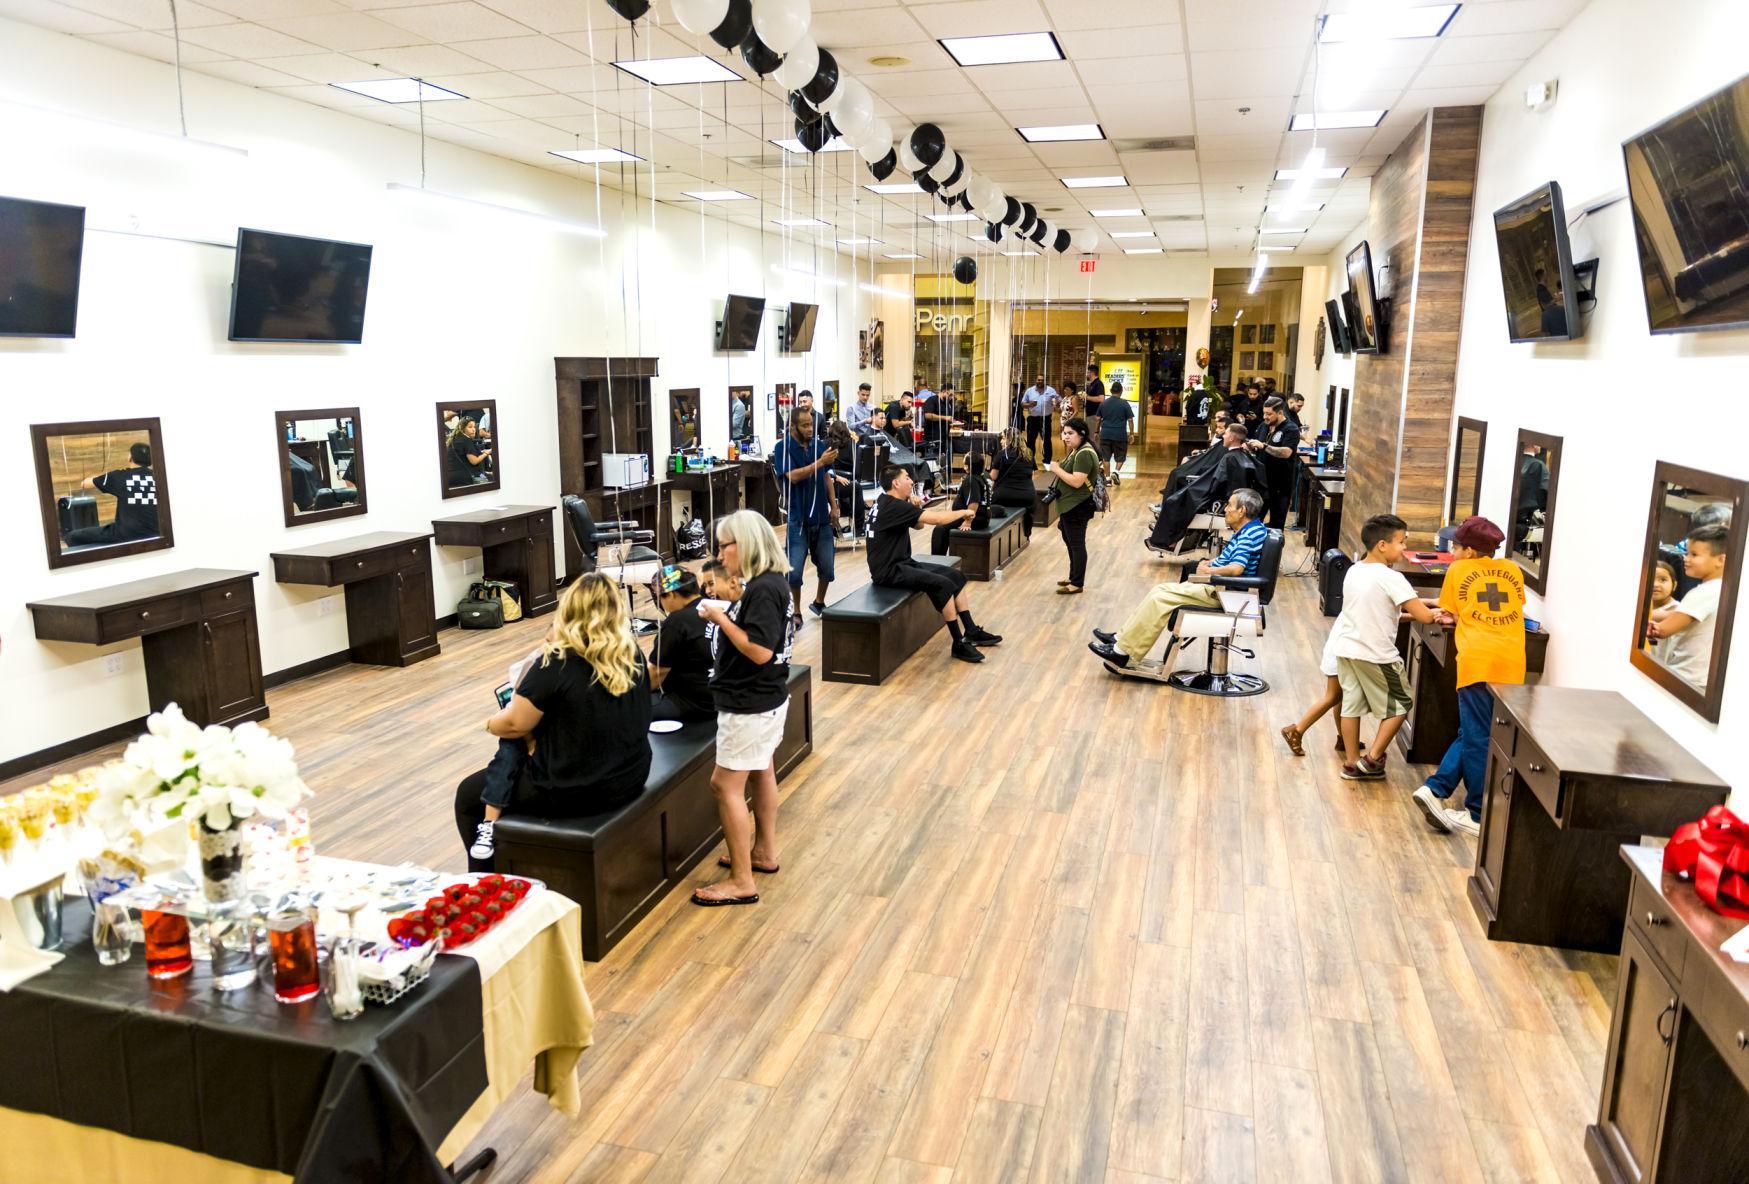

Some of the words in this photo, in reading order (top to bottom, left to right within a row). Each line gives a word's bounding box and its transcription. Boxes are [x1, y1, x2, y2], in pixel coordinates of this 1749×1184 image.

[1458, 570, 1481, 602] JUNIOR
[1471, 610, 1484, 622] EL
[1485, 610, 1520, 626] CENTRO
